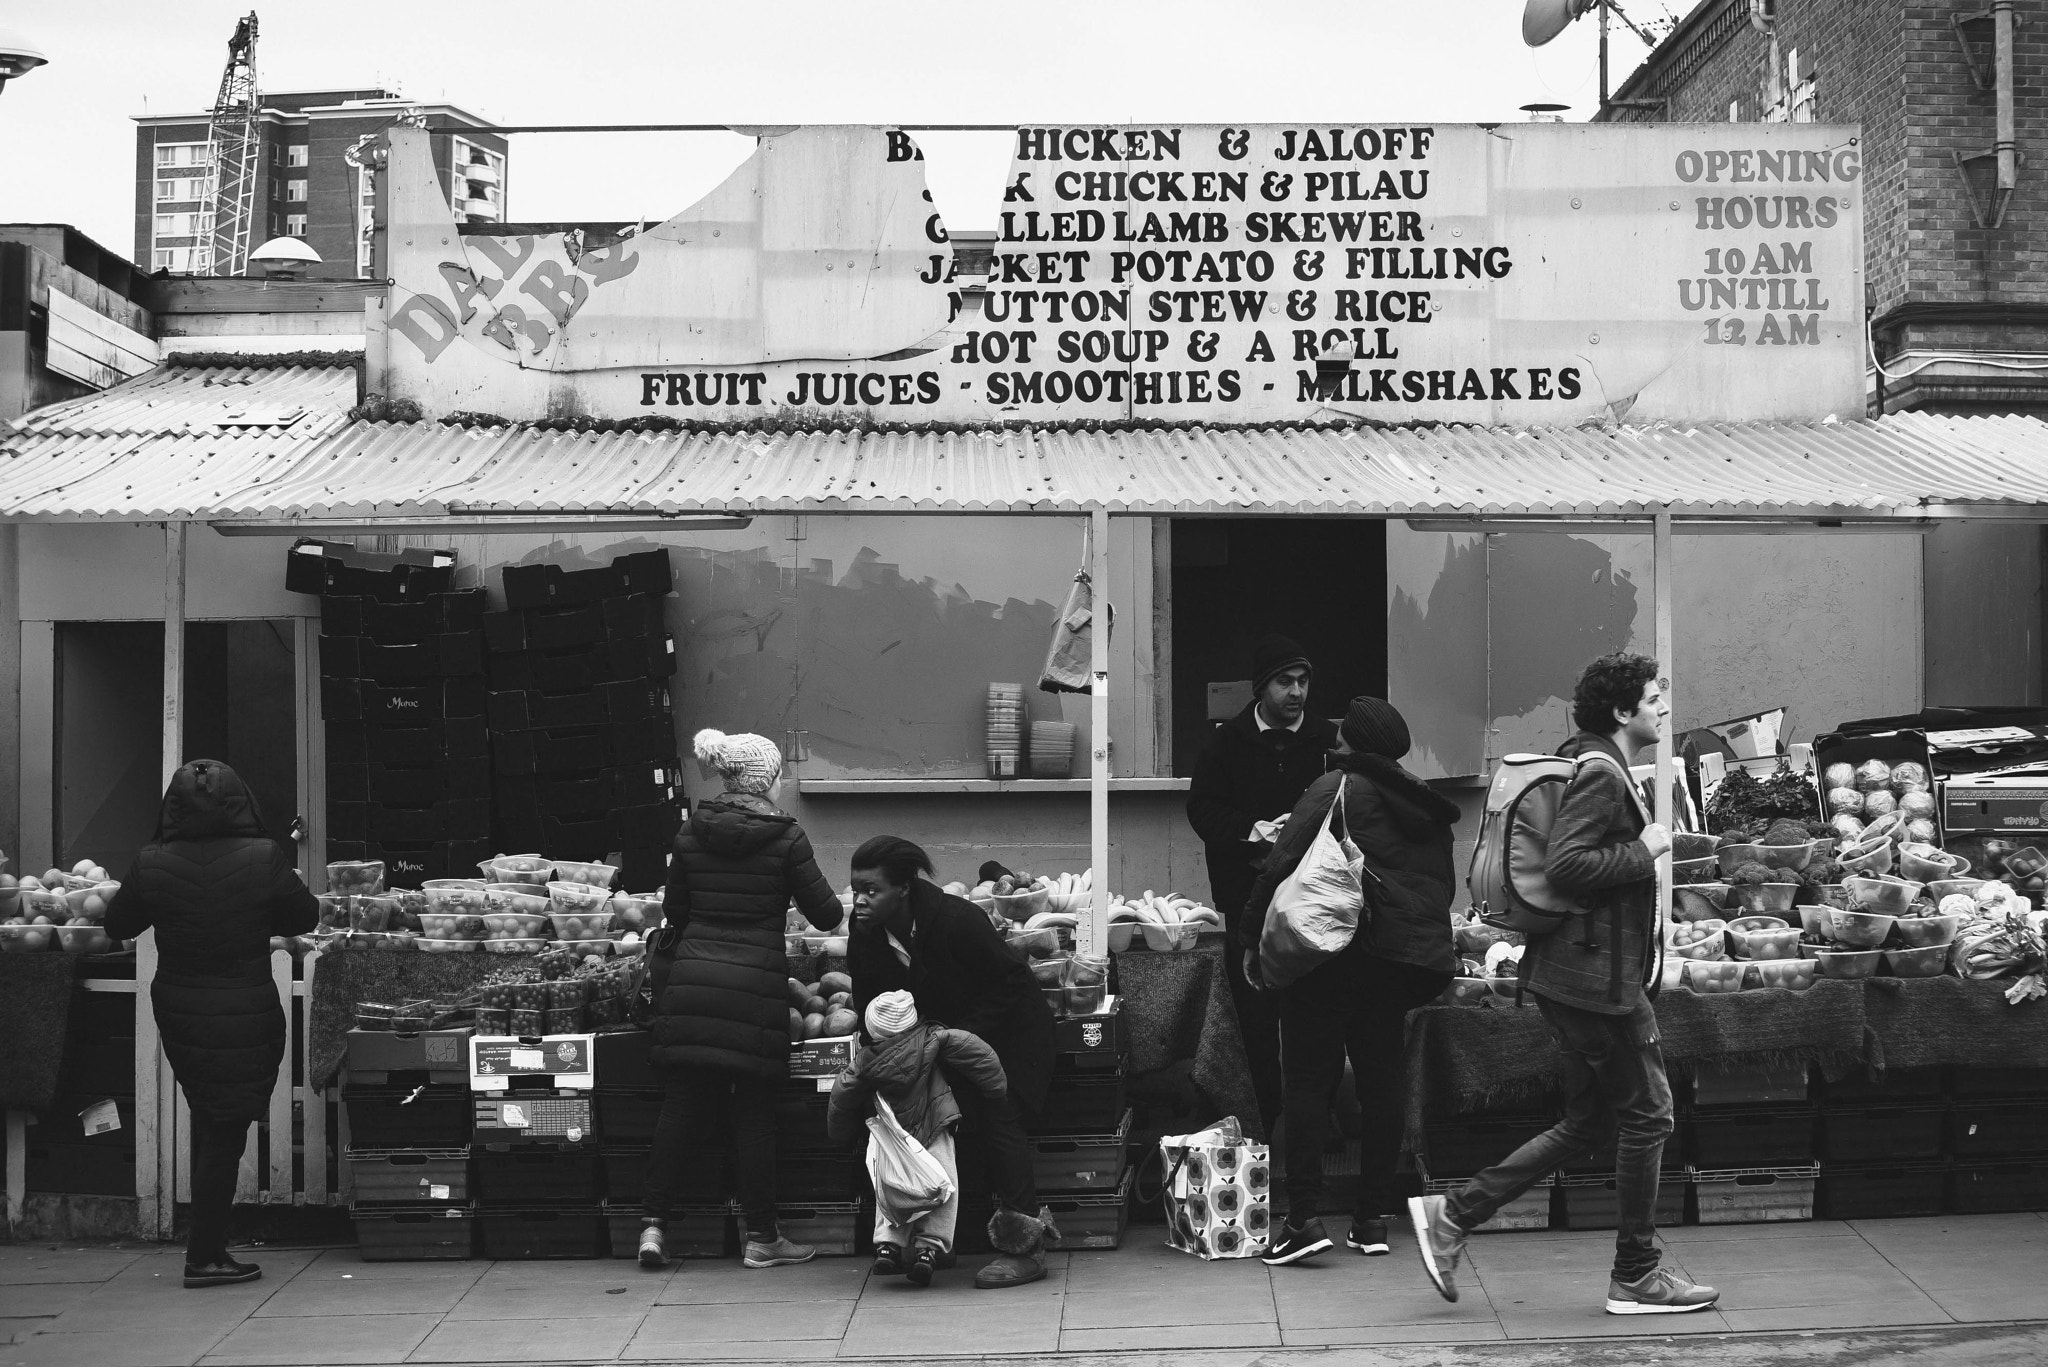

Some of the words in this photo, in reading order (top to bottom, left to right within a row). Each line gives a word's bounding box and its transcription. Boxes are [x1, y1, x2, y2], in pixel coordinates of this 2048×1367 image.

[1017, 128, 1182, 162] HICKEN
[1218, 127, 1250, 161] &
[1274, 127, 1435, 162] JALOFF
[1676, 149, 1863, 184] OPENING
[1054, 170, 1249, 202] CHICKEN
[1260, 170, 1294, 202] &
[1303, 169, 1430, 202] PILAU
[925, 209, 1106, 244] GLLED
[1112, 211, 1229, 243] LAMB
[1245, 210, 1425, 243] SKEWER
[1694, 195, 1838, 230] HOURS
[1110, 250, 1275, 283] POTATO
[1292, 249, 1325, 282] &
[1345, 246, 1513, 280] FILLING
[1703, 247, 1747, 276] 10
[1749, 241, 1813, 276] AM
[1148, 290, 1269, 323] STEW
[1285, 289, 1317, 322] &
[1334, 290, 1433, 323] RICE
[1677, 277, 1830, 311] UNTILL
[950, 330, 1037, 364] HOT
[1057, 329, 1169, 364] SOUP
[1186, 329, 1220, 363] &
[1245, 329, 1276, 363] A
[1703, 317, 1747, 347] 12
[1754, 312, 1821, 346] AM
[640, 372, 768, 406] FRUIT
[786, 371, 941, 406] JUICES
[986, 370, 1242, 405] SMOOTHIES
[387, 696, 420, 710] Maroc
[392, 859, 425, 873] Maroc
